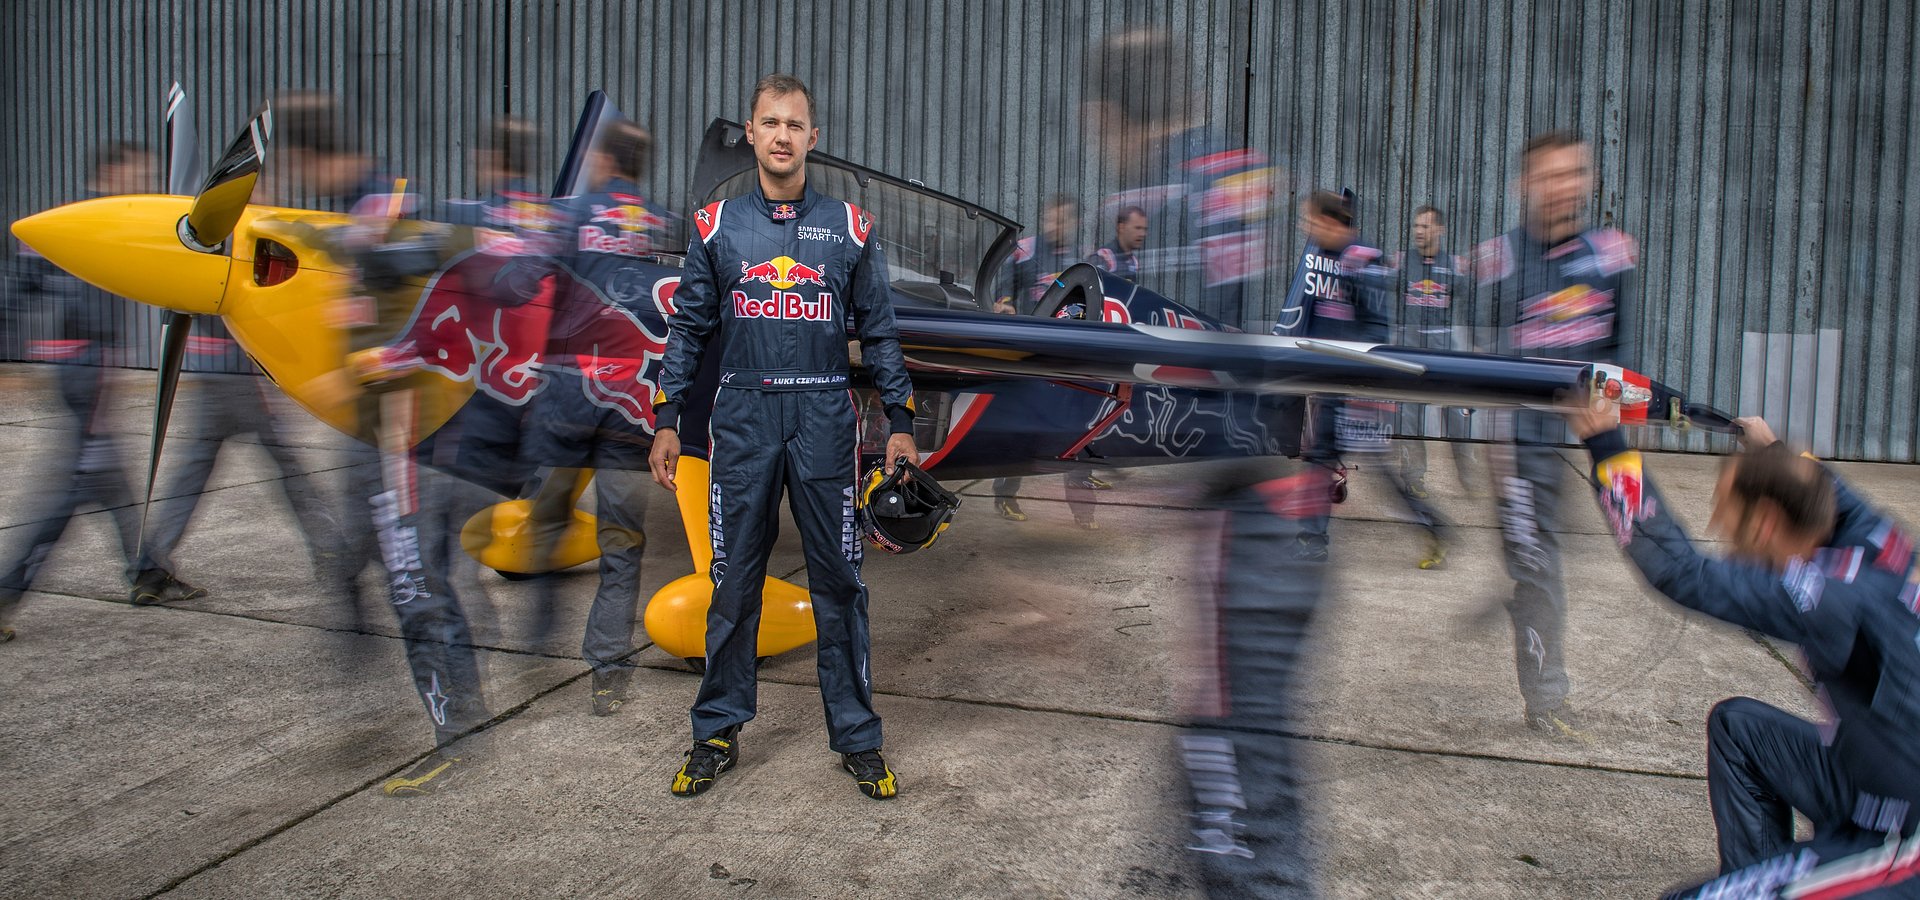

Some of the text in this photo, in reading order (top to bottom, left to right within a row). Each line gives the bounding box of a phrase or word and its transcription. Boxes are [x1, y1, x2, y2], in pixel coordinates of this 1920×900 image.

[797, 231, 844, 244] SMART TV
[798, 226, 831, 234] SAMSUNG
[1305, 253, 1353, 278] SAMS
[732, 290, 832, 322] Red Bull
[773, 377, 795, 385] LUKE
[795, 377, 830, 385] CZEPIELA
[712, 482, 727, 559] CZEPIELA
